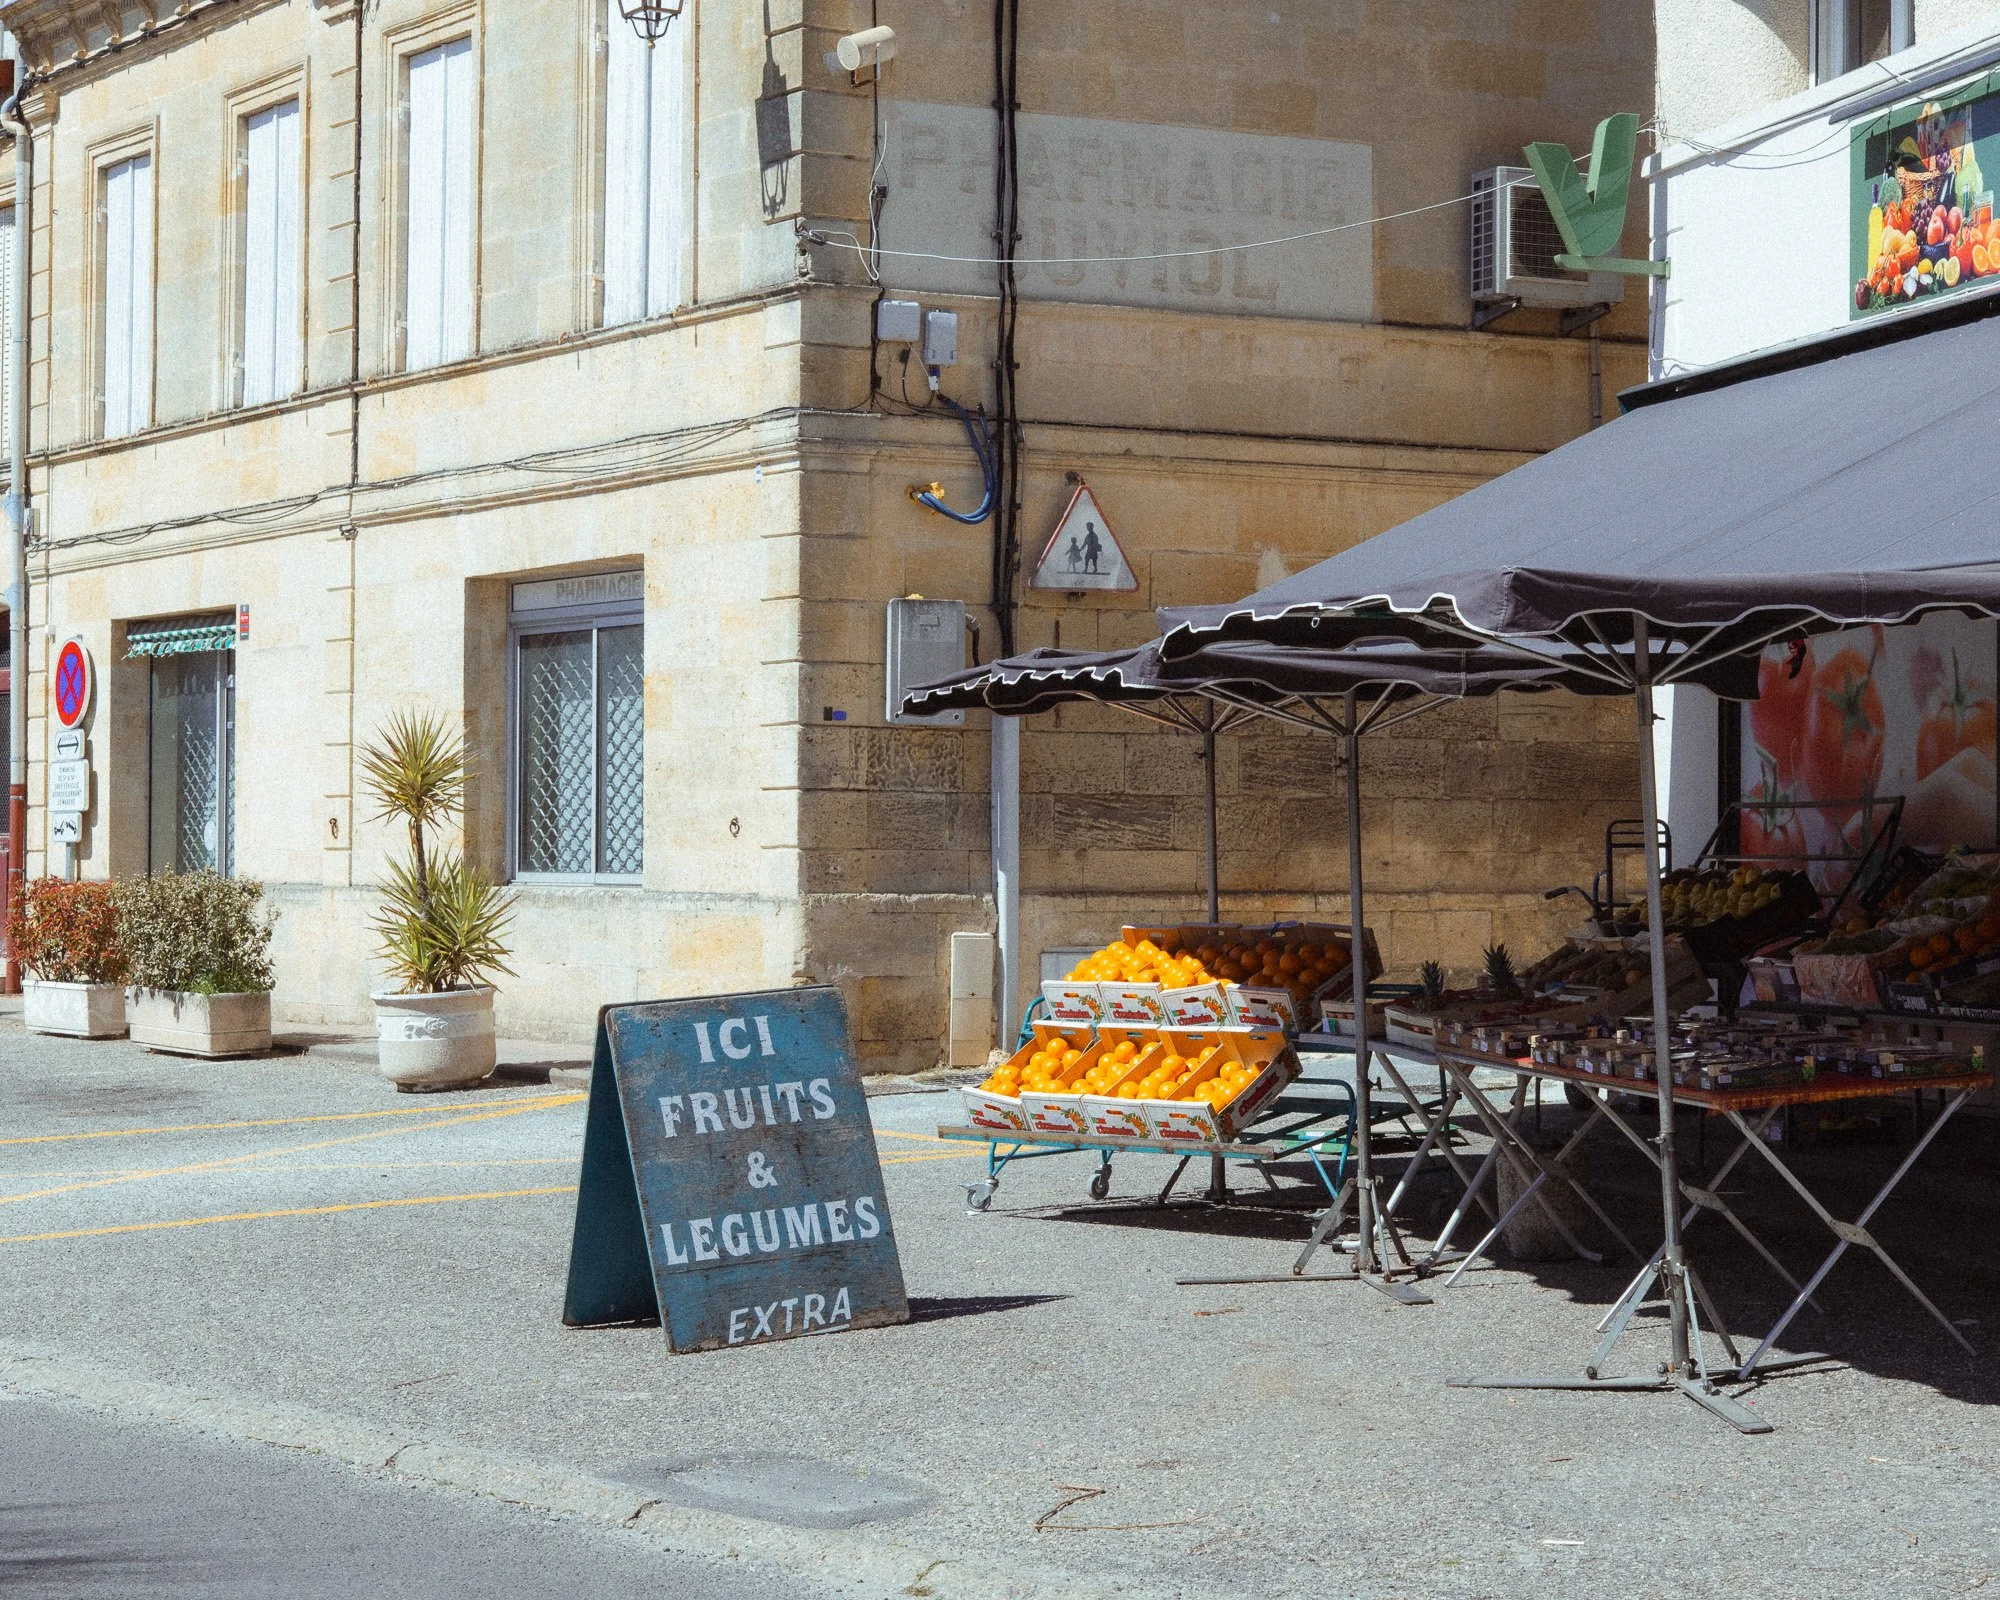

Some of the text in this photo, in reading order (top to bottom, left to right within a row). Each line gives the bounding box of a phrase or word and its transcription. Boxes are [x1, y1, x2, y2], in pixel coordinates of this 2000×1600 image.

[900, 122, 1346, 226] PHARMACIE
[555, 573, 643, 603] PHARMACIE
[693, 1015, 776, 1063] ICI
[658, 1078, 836, 1138] FRUITS
[747, 1151, 777, 1188] &
[660, 1197, 881, 1266] LEGUMES
[728, 1287, 852, 1344] EXTRA
